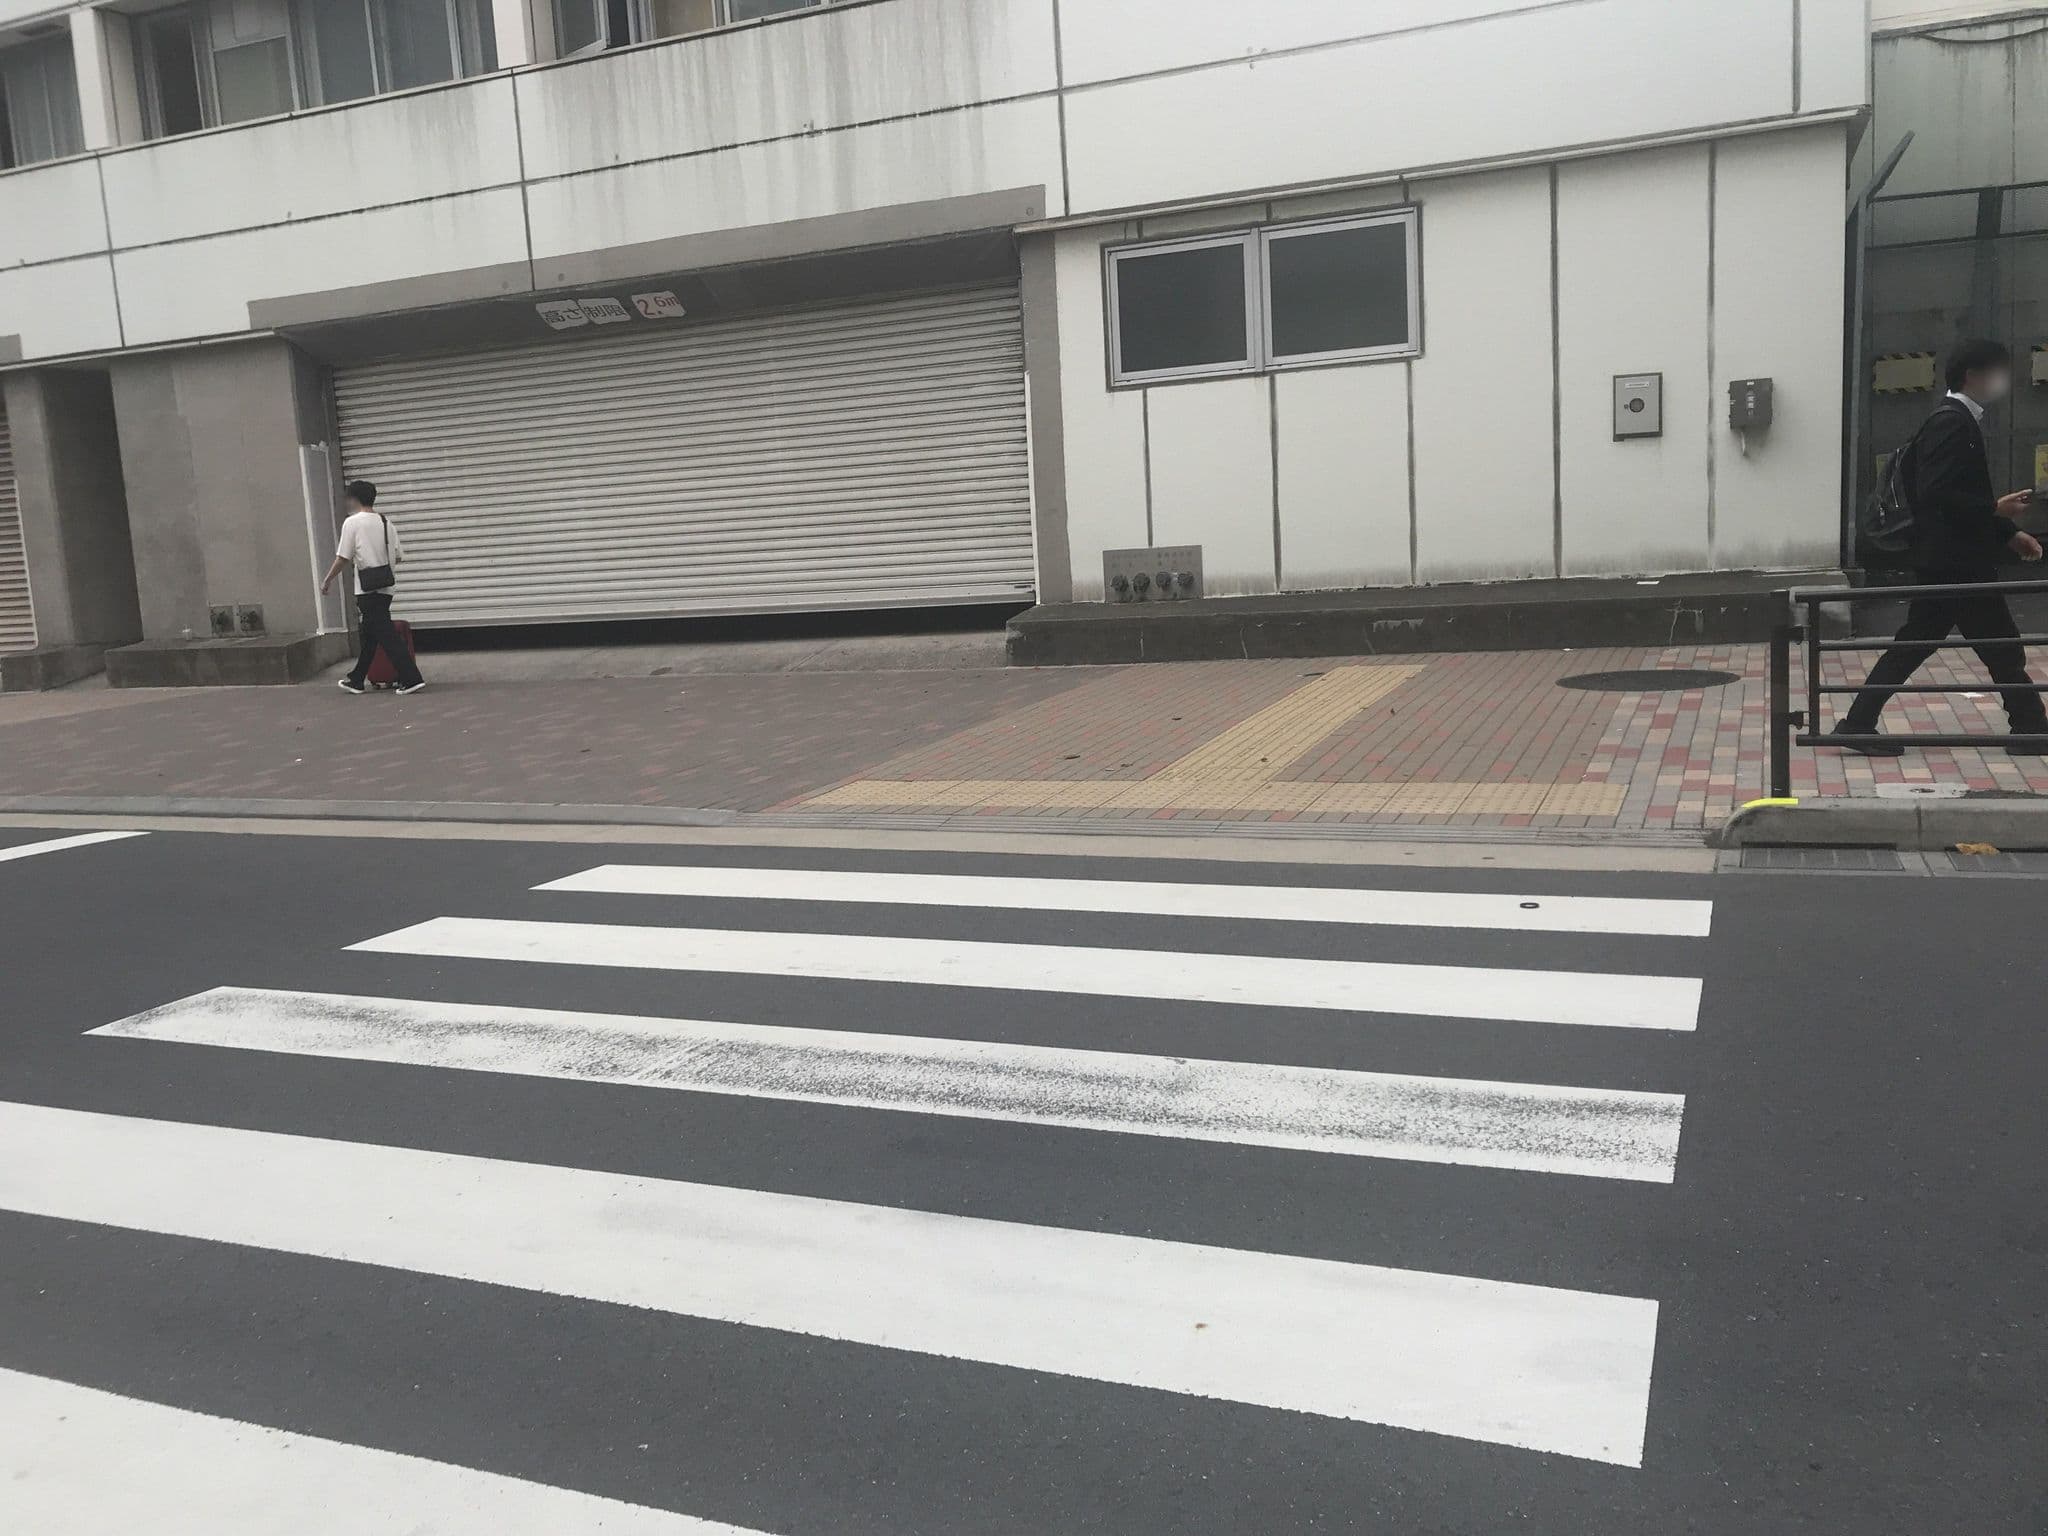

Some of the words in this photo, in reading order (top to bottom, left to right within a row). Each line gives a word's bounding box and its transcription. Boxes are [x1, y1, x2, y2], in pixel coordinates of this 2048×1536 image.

[541, 304, 626, 323] 高さ制限
[637, 296, 680, 316] 2.6m
